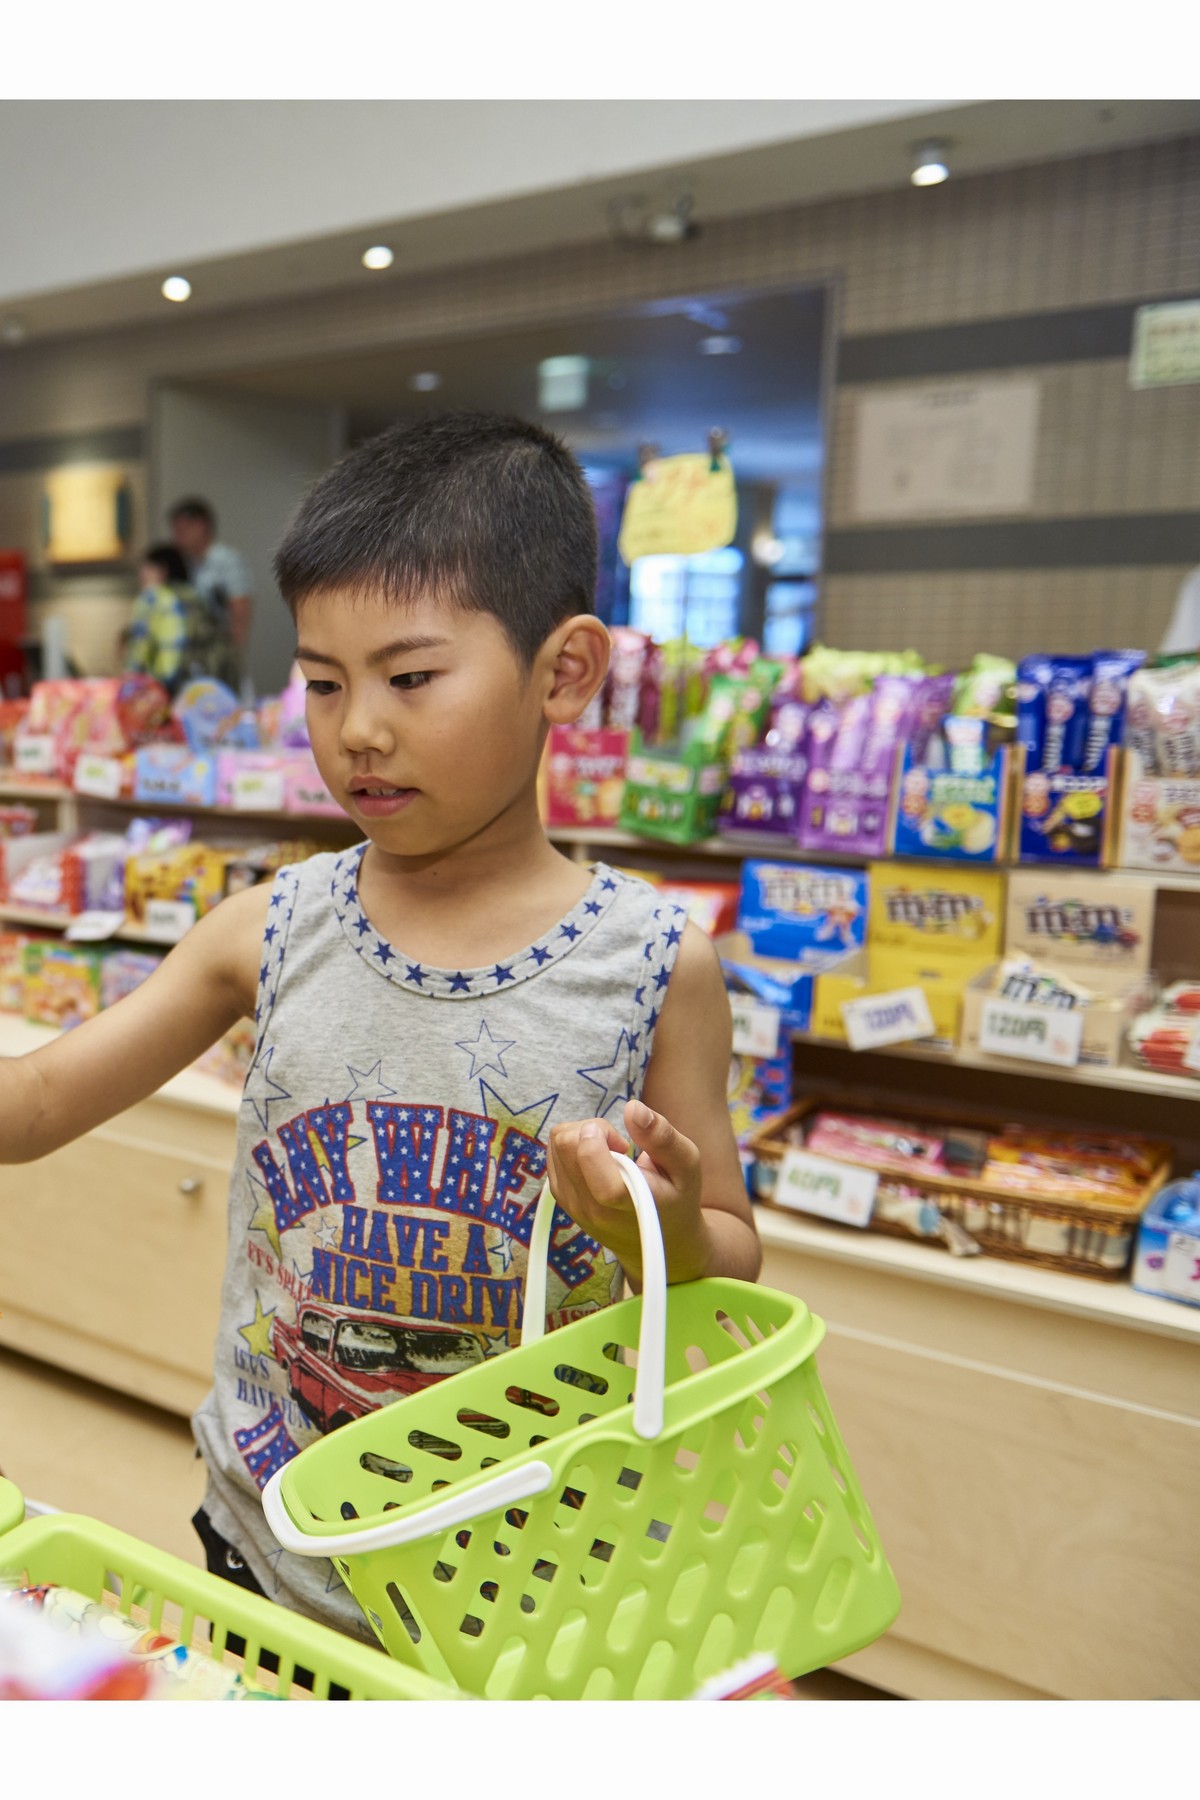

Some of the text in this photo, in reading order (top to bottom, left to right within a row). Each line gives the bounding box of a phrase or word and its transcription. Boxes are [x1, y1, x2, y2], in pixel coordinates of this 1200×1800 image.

[252, 1102, 356, 1234] ANY
[340, 1205, 492, 1275] HAVE A
[311, 1246, 523, 1330] NICE DRIV
